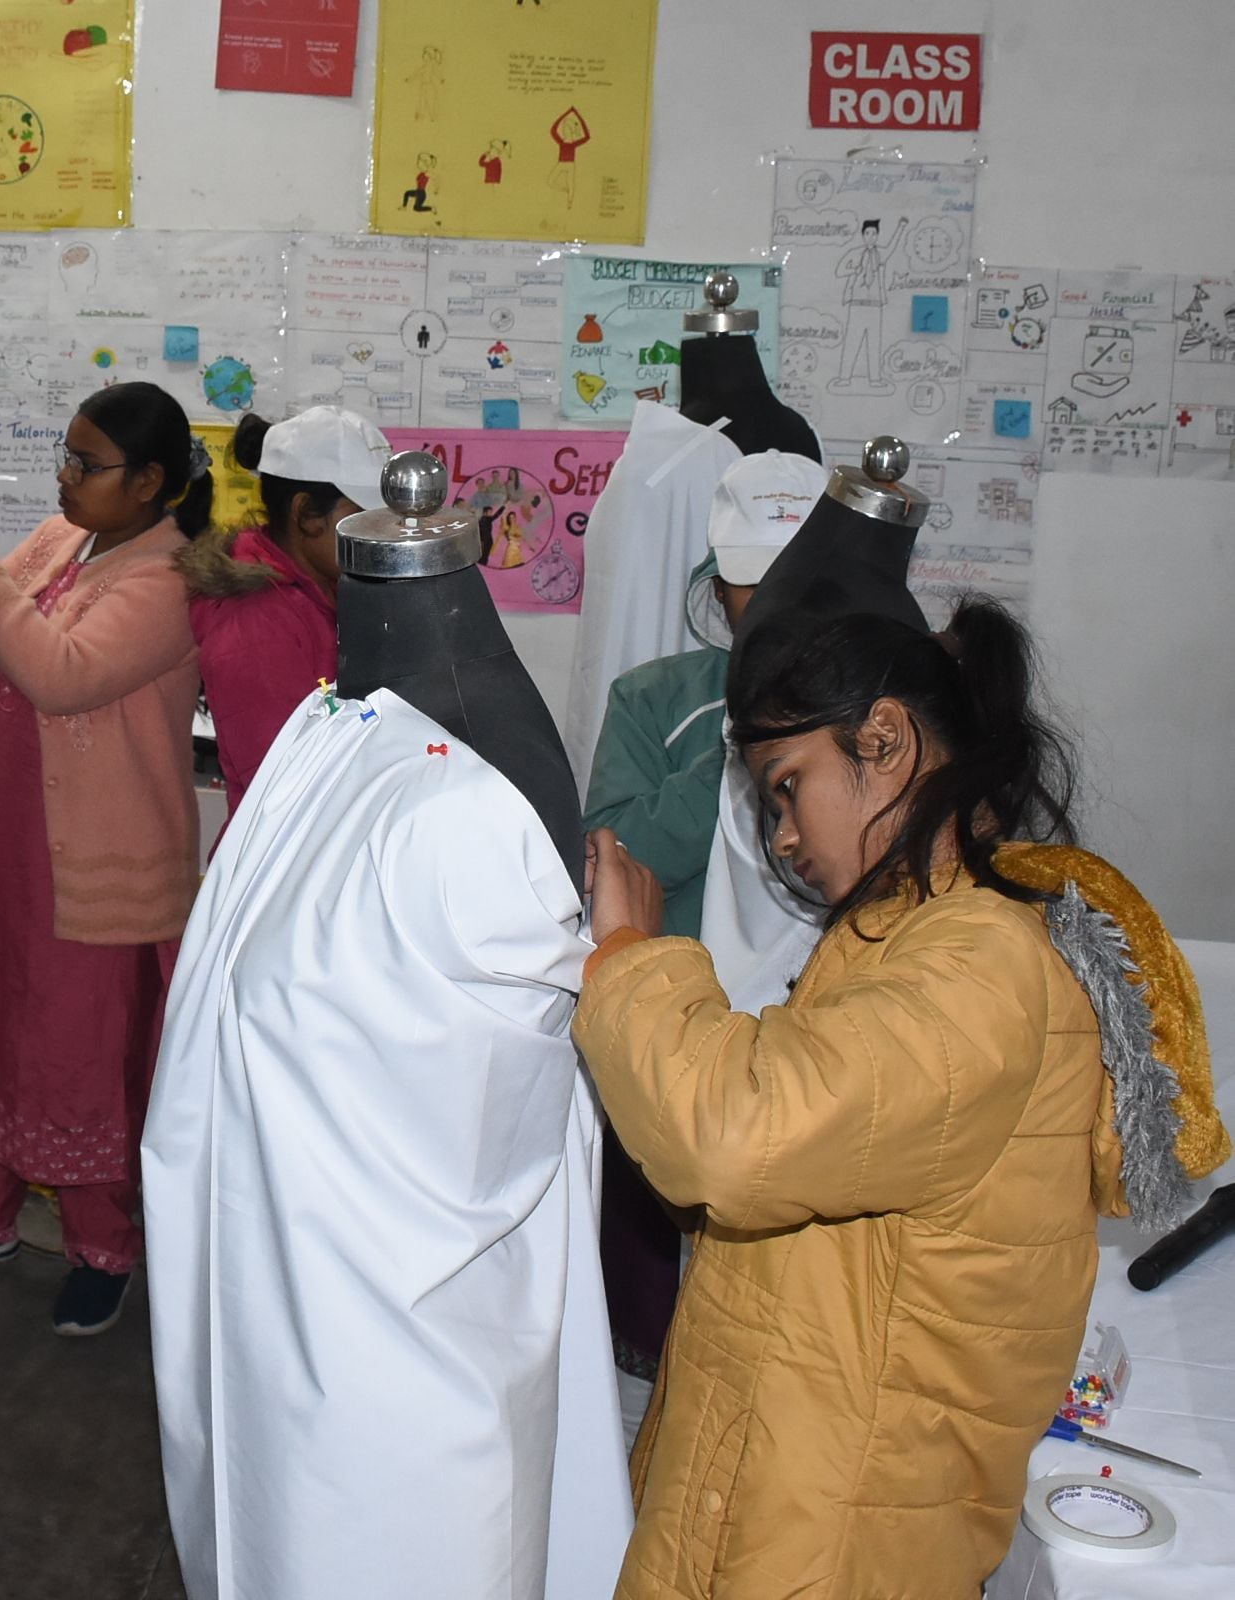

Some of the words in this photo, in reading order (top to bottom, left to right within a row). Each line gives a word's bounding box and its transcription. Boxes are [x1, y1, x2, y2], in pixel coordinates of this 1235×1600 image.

[823, 42, 971, 81] CLASS
[828, 89, 963, 126] ROOM
[592, 258, 638, 281] BUDGET
[630, 286, 692, 308] BUDGET
[1102, 291, 1156, 305] Financial
[570, 344, 613, 359] FINANCE
[635, 367, 670, 381] CASH
[6, 420, 66, 441] Tailoring
[1090, 1492, 1119, 1503] wonder
